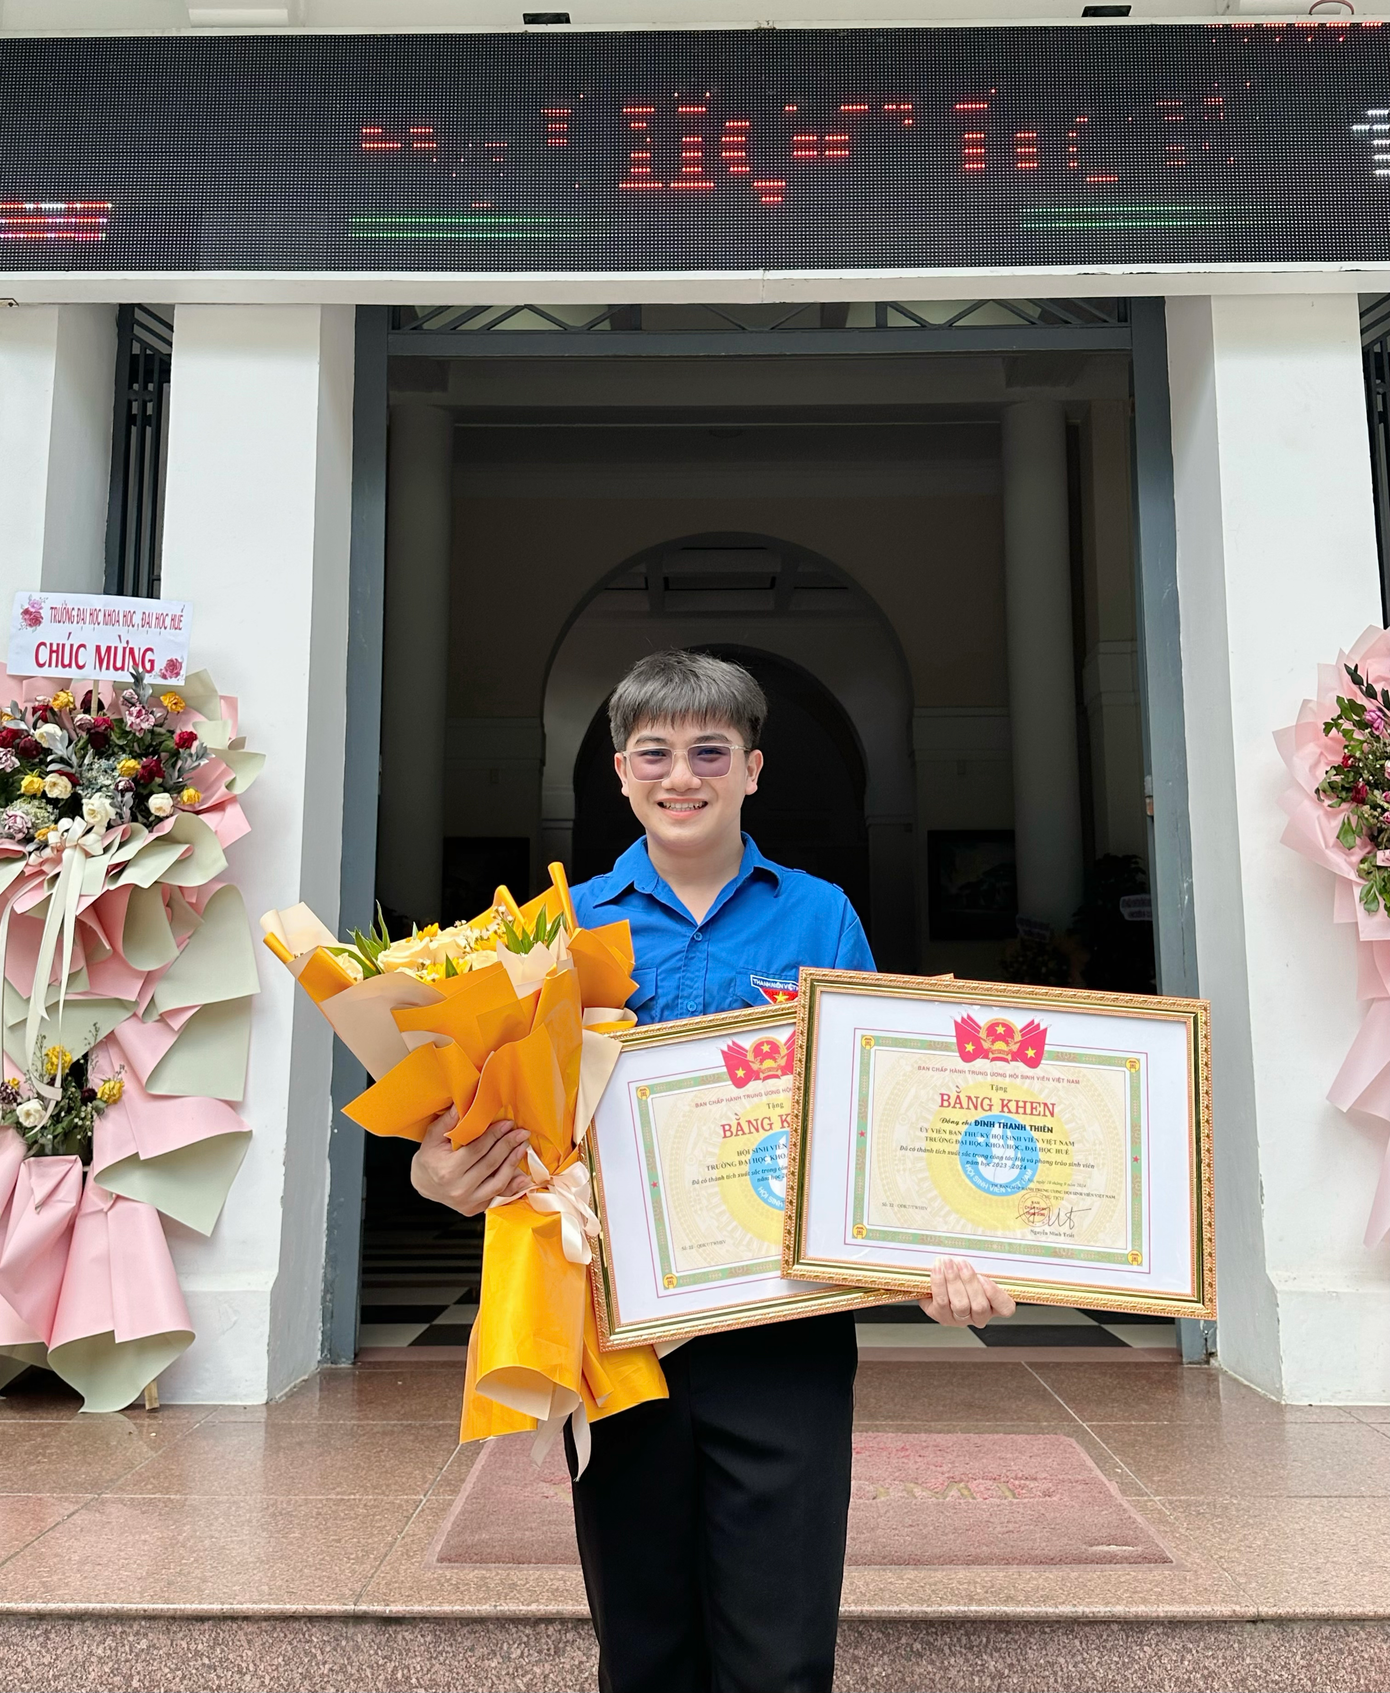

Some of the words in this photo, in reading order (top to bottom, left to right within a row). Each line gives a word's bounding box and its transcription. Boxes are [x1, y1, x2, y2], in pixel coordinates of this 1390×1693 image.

[76, 607, 88, 631] ĐẠI
[88, 608, 102, 631] HỌC
[102, 608, 121, 627] KHOA
[141, 611, 153, 635] ĐẠI
[154, 612, 169, 635] HỌC
[169, 604, 186, 631] HUẾ
[34, 631, 87, 670] CHÚC
[94, 634, 156, 674] MỪNG
[968, 1069, 988, 1077] TRUNG
[1037, 1074, 1051, 1082] VIÊN
[1066, 1077, 1081, 1085] NAM
[990, 1084, 1008, 1093] Tặng
[743, 1092, 763, 1100] TRUNG
[939, 1085, 994, 1112] BẰNG
[1000, 1099, 1056, 1118] KHEN
[766, 1102, 784, 1110] Tặng
[720, 1112, 774, 1139] BẰNG
[997, 1121, 1026, 1131] THANH
[1028, 1124, 1054, 1133] THIÊN
[931, 1126, 947, 1136] VIÊN
[991, 1132, 1004, 1141] HỘI
[1005, 1134, 1022, 1142] SINH
[1023, 1135, 1040, 1143] VIÊN
[1041, 1137, 1057, 1146] VIỆT
[737, 1149, 750, 1157] HỘI
[752, 1146, 769, 1154] SINH
[955, 1139, 968, 1147] ĐẠI
[969, 1140, 983, 1148] HỌC
[985, 1141, 1005, 1149] KHOA
[1025, 1145, 1037, 1153] ĐẠI
[738, 1158, 751, 1167] ĐẠI
[752, 1155, 768, 1164] HỌC
[1035, 1158, 1053, 1167] phong
